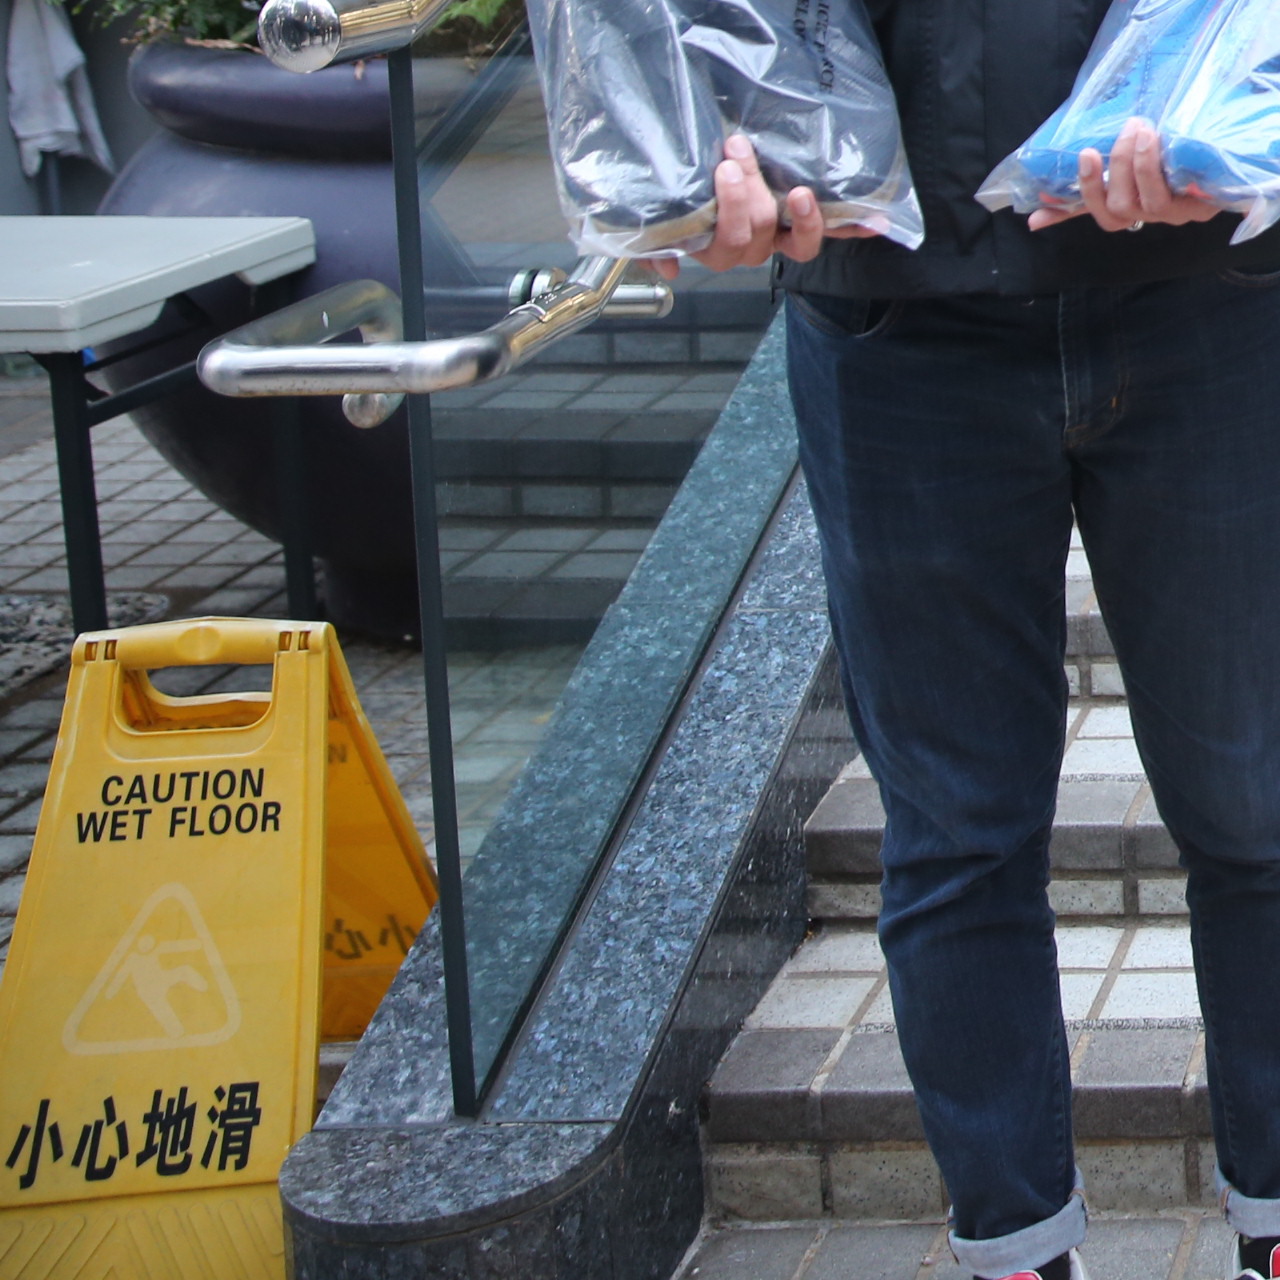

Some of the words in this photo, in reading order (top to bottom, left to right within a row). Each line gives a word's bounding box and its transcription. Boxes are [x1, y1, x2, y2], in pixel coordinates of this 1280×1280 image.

[814, 40, 835, 94] FRCE
[101, 767, 265, 807] CAUTION
[76, 809, 153, 844] WET
[169, 801, 282, 838] FLOOR
[5, 1081, 262, 1190] 小心地滑
